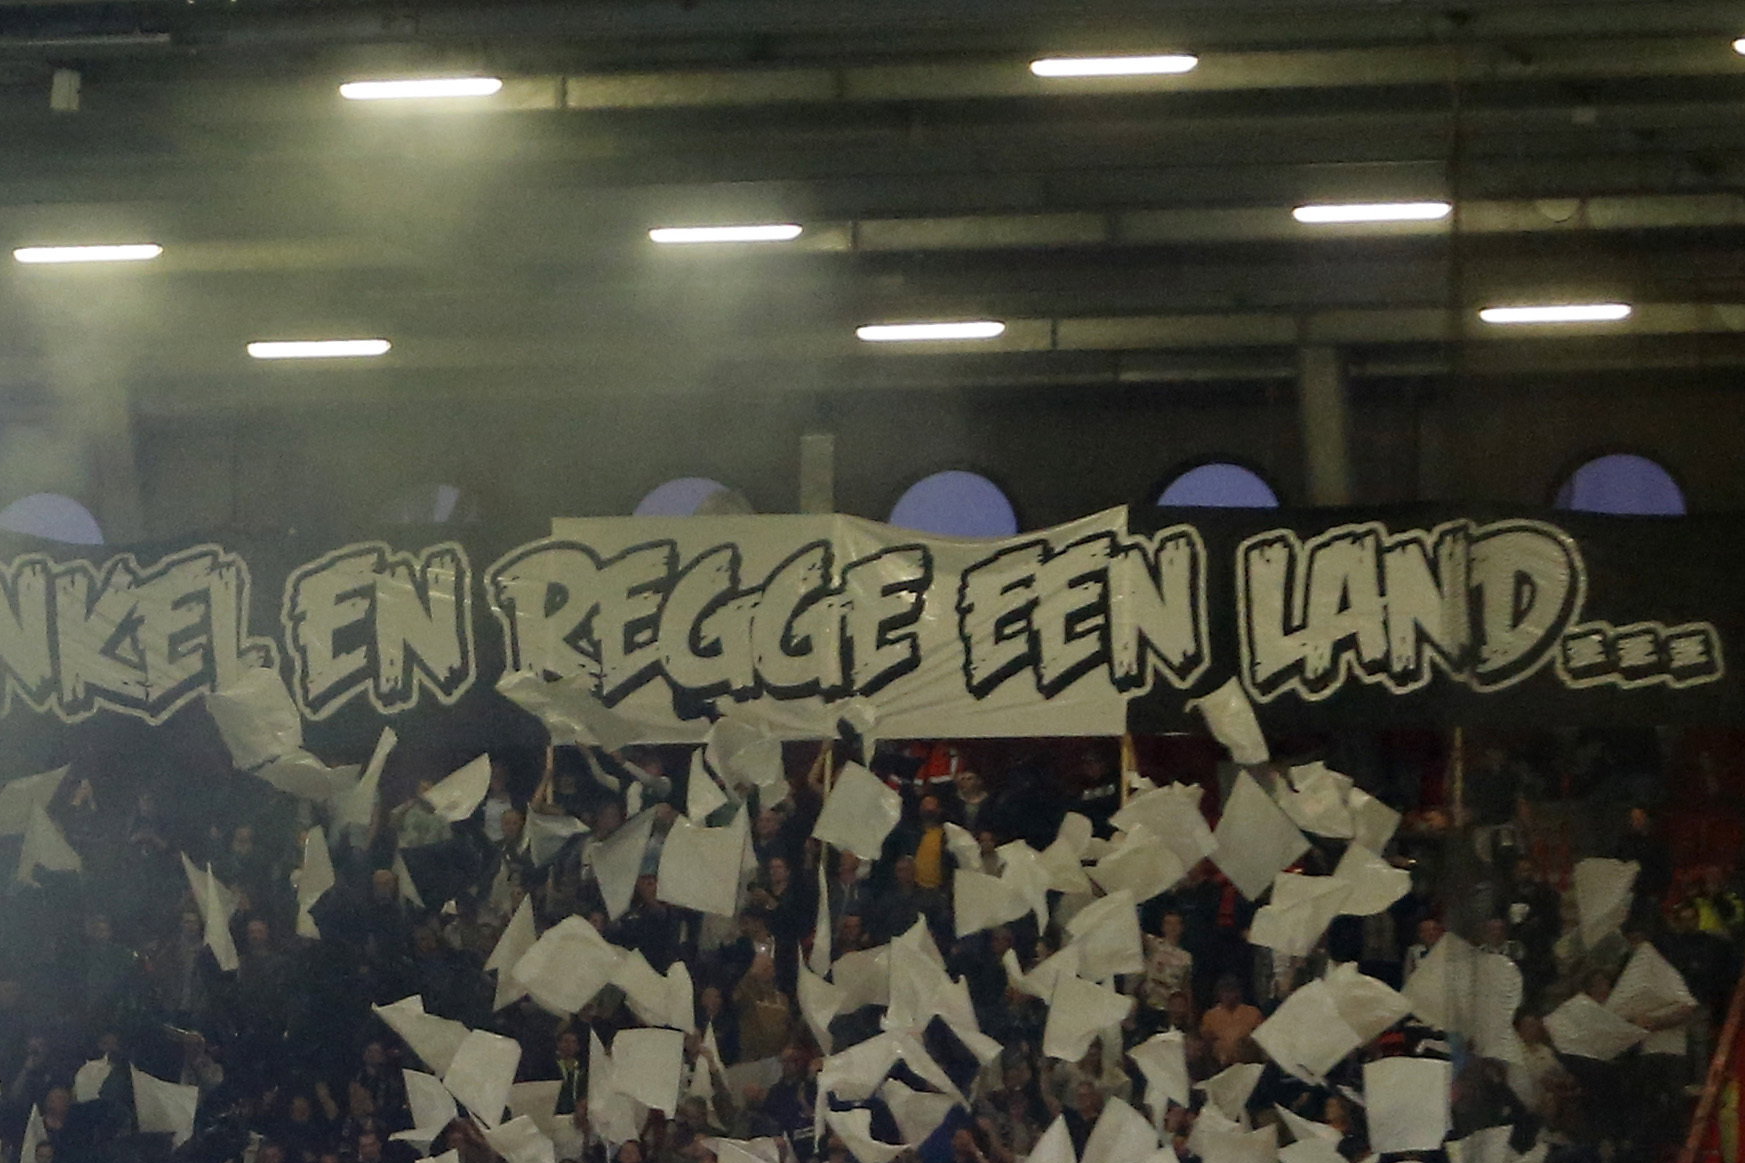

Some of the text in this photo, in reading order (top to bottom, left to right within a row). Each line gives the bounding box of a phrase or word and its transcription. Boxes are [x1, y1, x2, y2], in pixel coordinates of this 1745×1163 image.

[282, 541, 476, 721] EN
[485, 537, 934, 703] REGGE
[957, 524, 1211, 701] EEN
